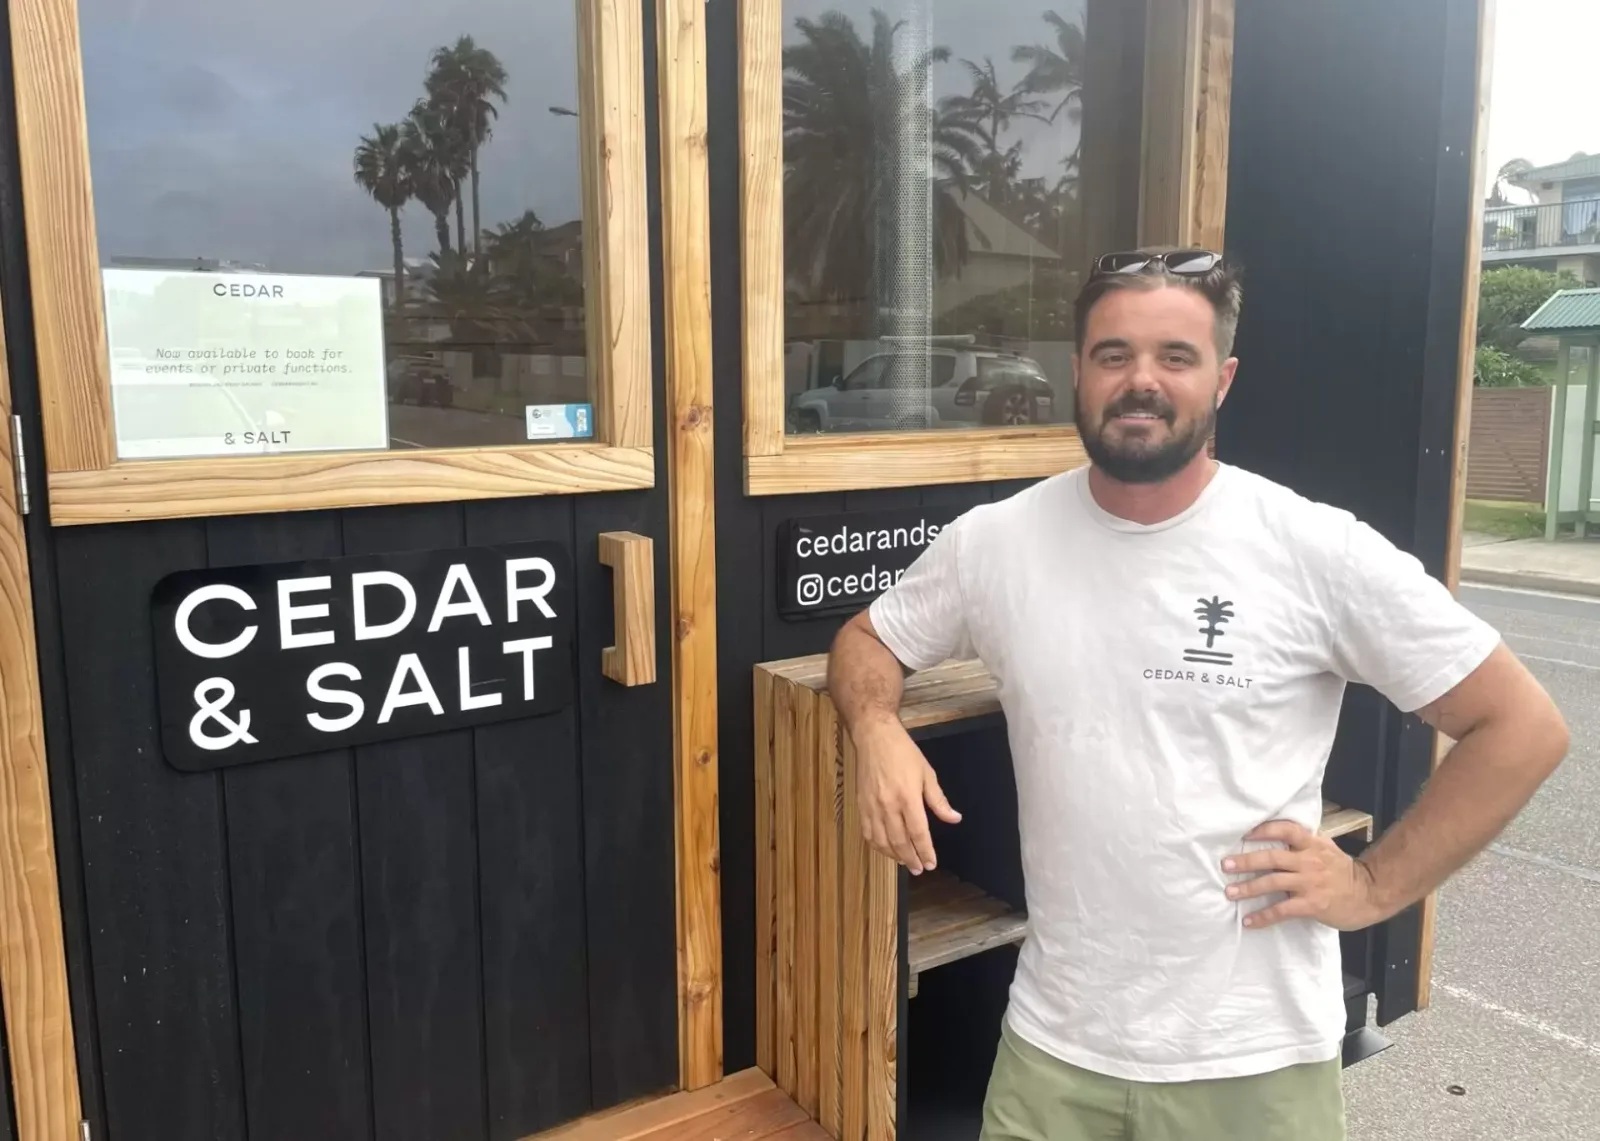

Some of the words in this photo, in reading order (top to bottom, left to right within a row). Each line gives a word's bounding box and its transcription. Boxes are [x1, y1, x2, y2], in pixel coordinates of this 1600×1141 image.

[213, 282, 284, 298] CEDAR
[155, 348, 181, 359] Now
[187, 347, 257, 359] available
[265, 349, 279, 359] to
[286, 348, 316, 359] book
[320, 348, 344, 361] for
[145, 363, 193, 374] events
[200, 365, 217, 374] or
[223, 362, 277, 376] private
[282, 362, 353, 376] functions.
[224, 432, 236, 445] &
[243, 430, 291, 445] SALT
[174, 556, 558, 659] CEDAR
[1143, 668, 1196, 682] CEDAR
[1200, 672, 1211, 684] &
[1216, 674, 1253, 689] SALT
[189, 676, 260, 751] &
[305, 635, 553, 733] SALT
